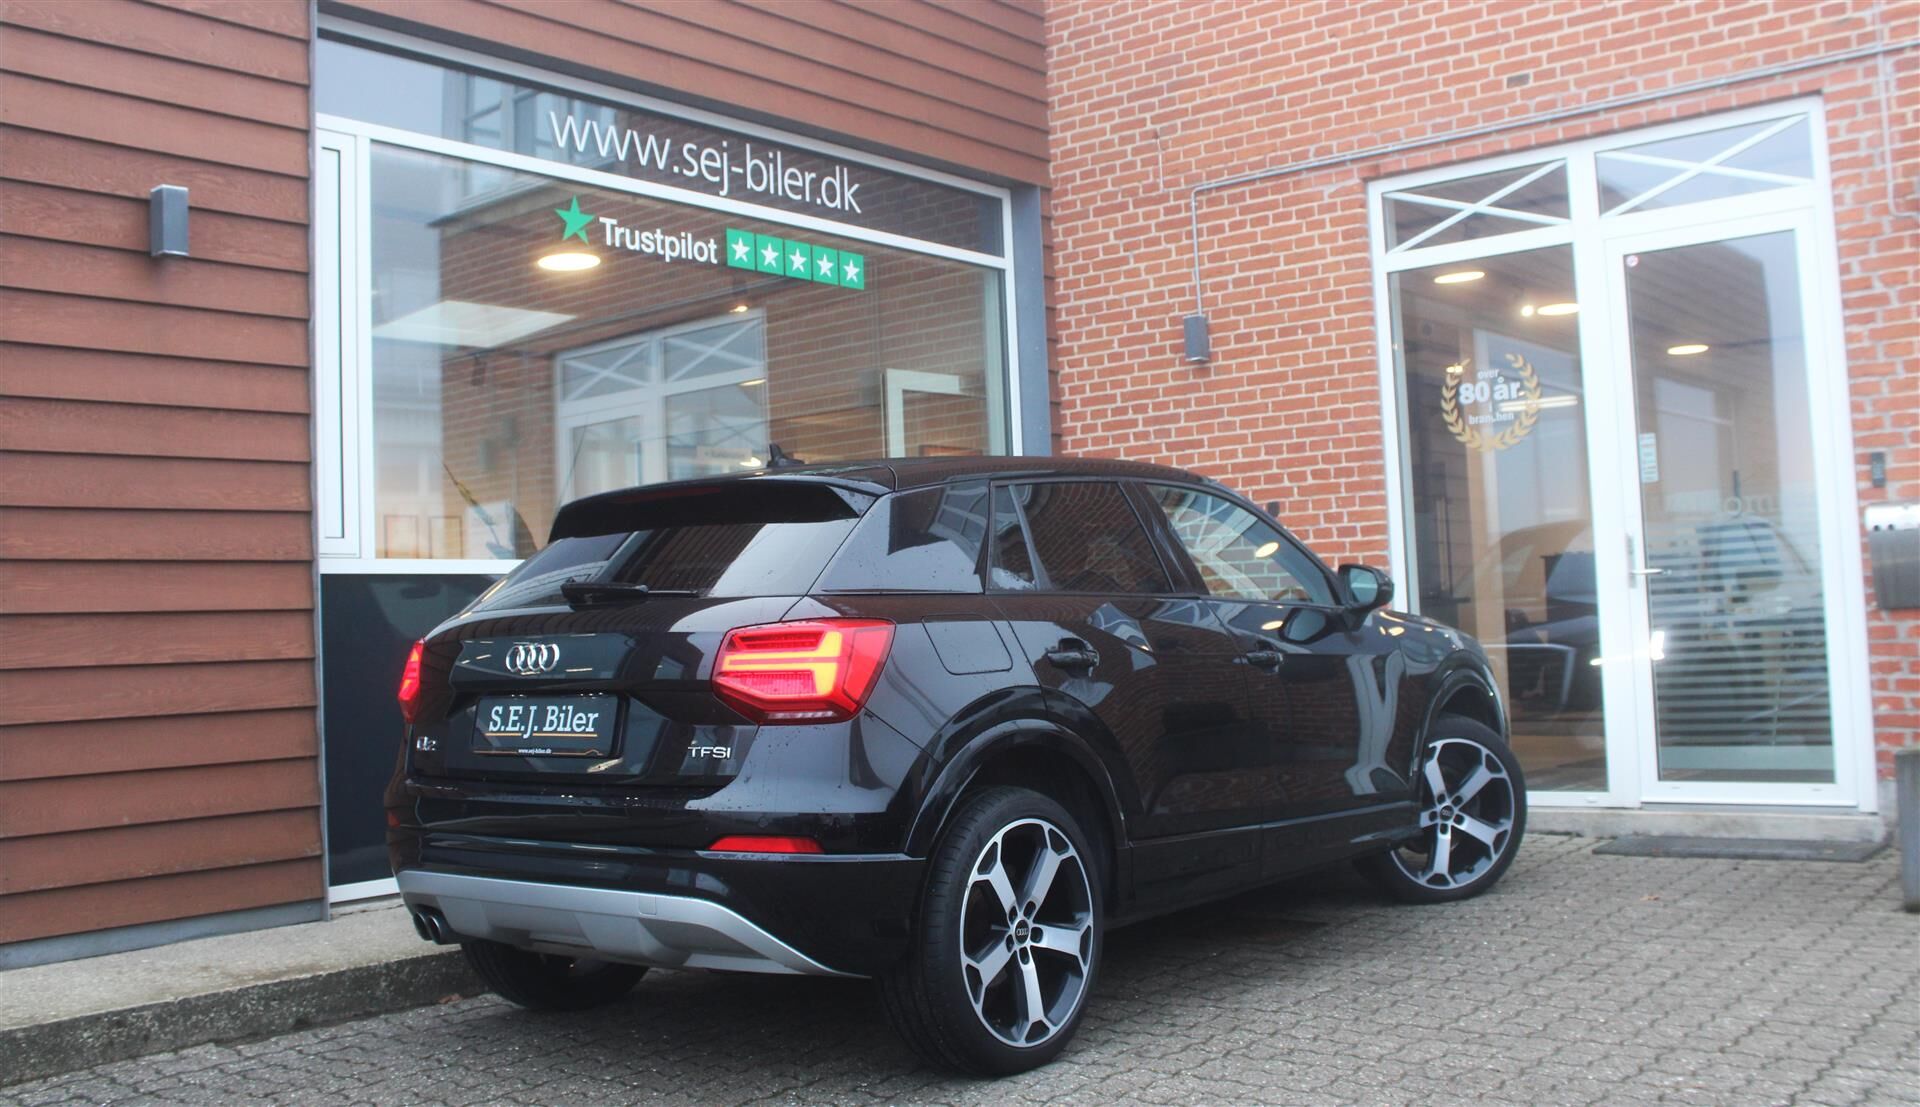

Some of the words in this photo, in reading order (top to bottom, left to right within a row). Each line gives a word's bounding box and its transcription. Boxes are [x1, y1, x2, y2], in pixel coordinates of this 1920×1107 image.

[550, 111, 862, 214] www.sej-biler.dk
[599, 216, 718, 265] Trustpilot
[1477, 368, 1500, 379] over
[1459, 381, 1490, 405] 80
[1493, 376, 1521, 401] år
[488, 705, 538, 739] S.E.J.
[542, 705, 600, 732] Biler
[687, 746, 731, 759] TFSI
